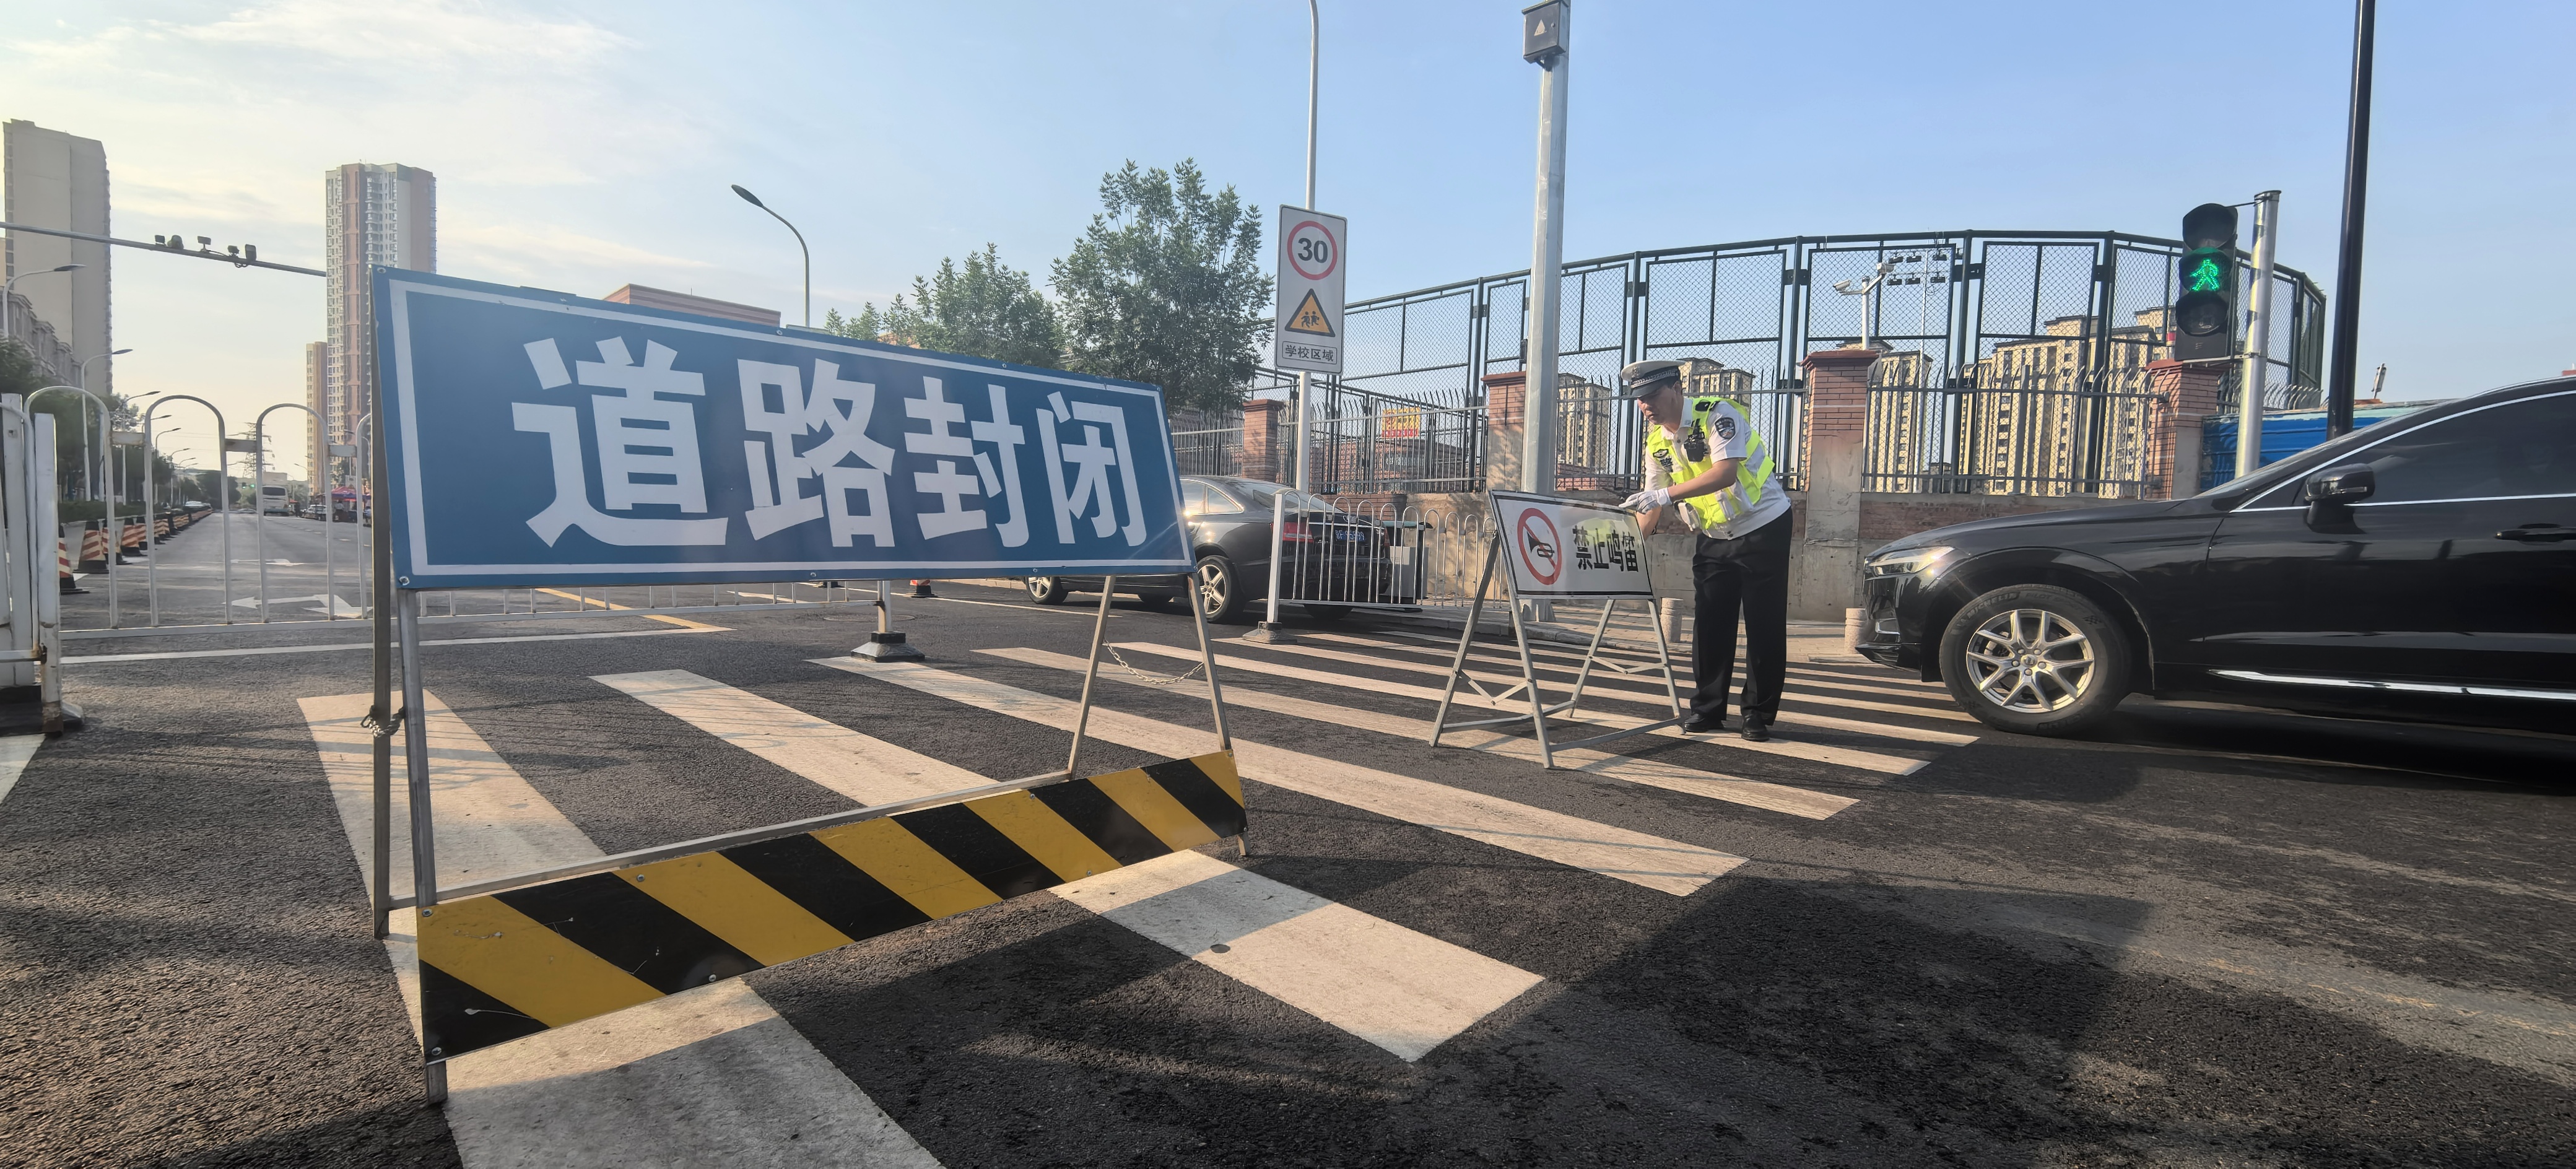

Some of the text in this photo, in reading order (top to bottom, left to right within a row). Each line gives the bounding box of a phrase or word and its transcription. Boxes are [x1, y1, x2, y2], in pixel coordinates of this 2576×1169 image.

[1298, 238, 1328, 263] 30
[1285, 345, 1334, 362] 学校区域
[511, 336, 1147, 547] 道路封闭
[1572, 524, 1638, 573] 禁止鸣笛
